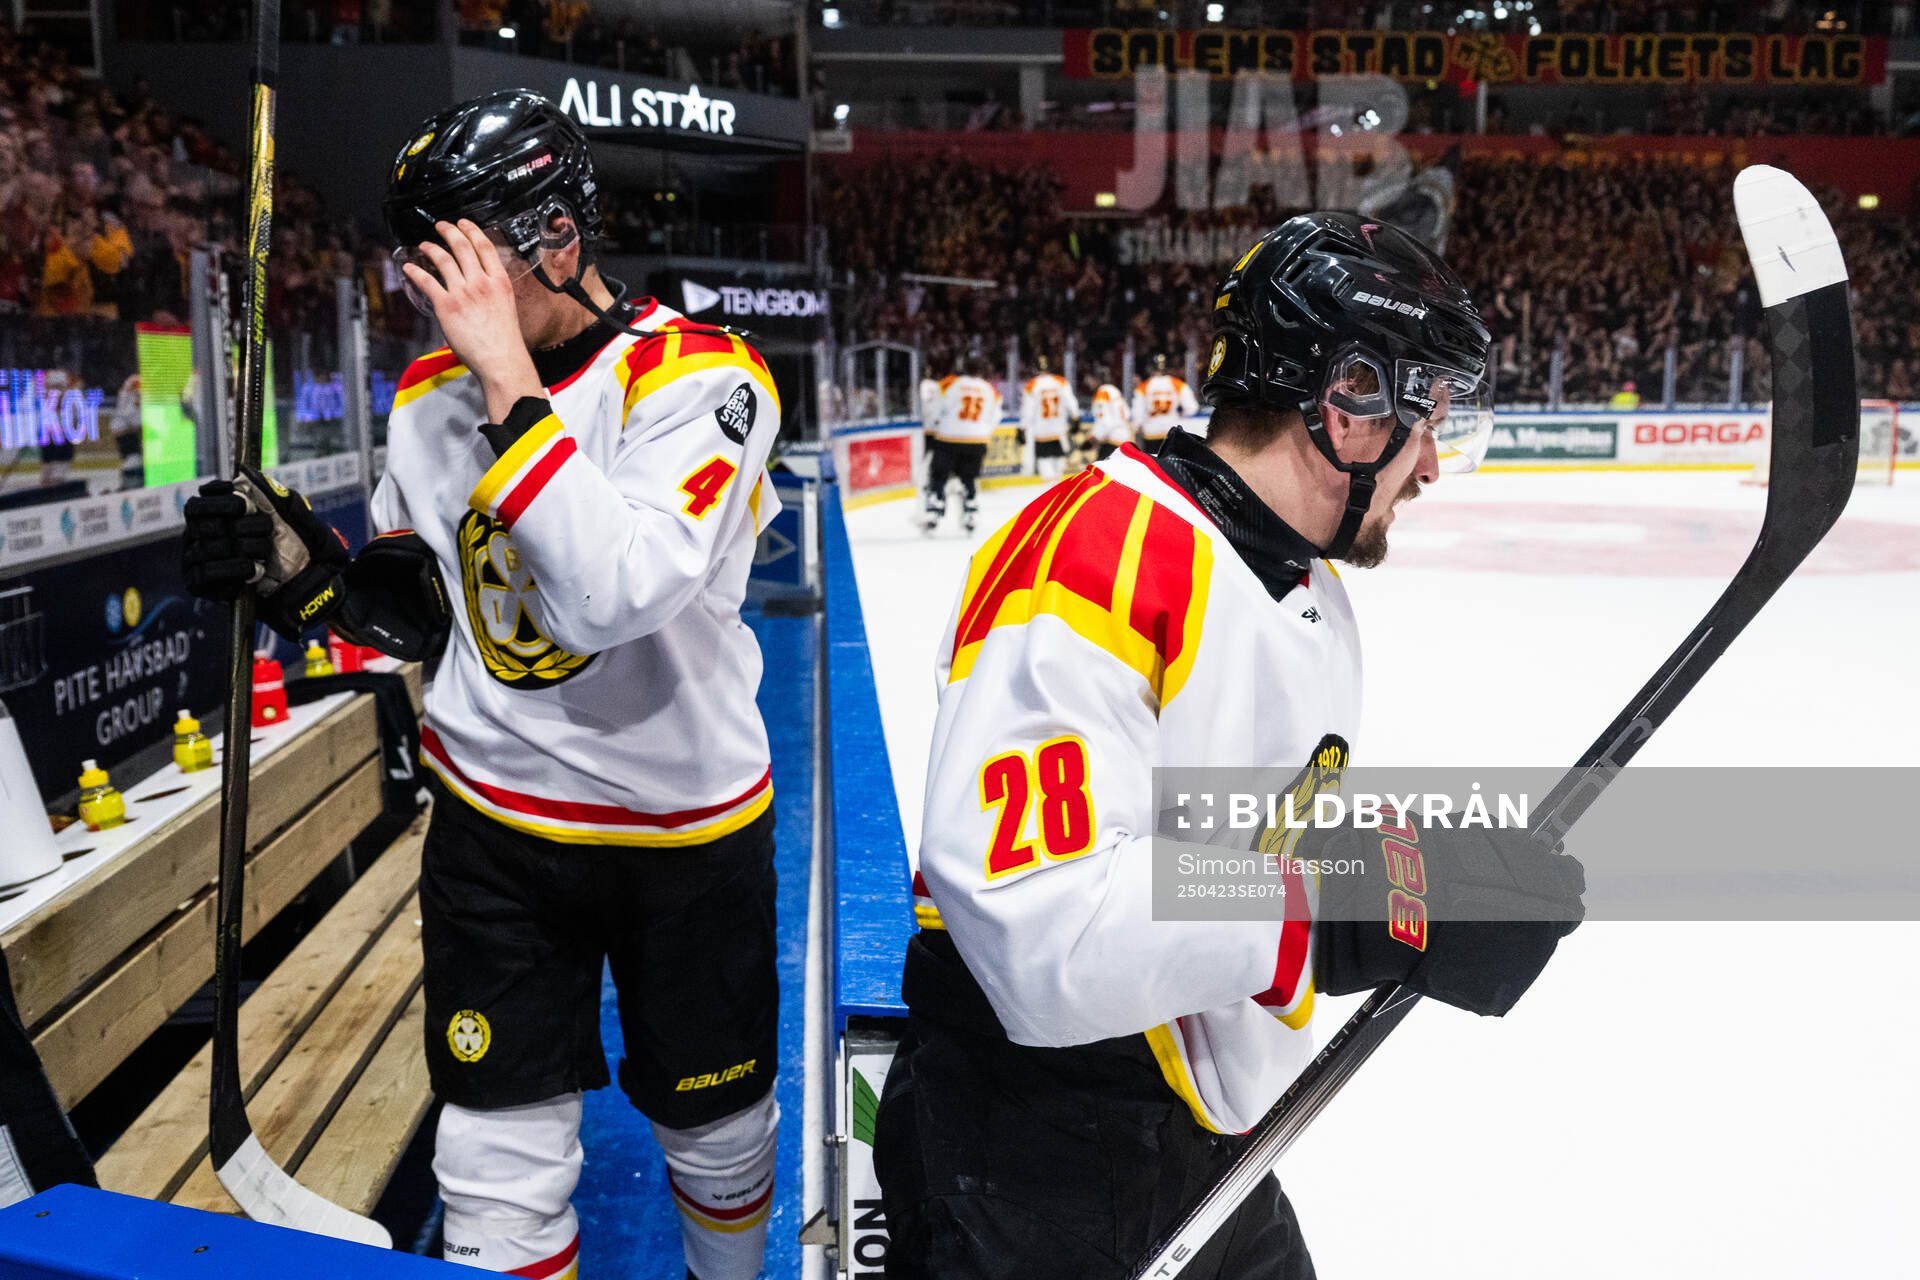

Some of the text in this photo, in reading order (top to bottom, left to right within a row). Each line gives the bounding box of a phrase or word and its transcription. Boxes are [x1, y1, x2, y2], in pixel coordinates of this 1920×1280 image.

[1091, 29, 1297, 80] SOLENS
[1308, 30, 1449, 81] STAD
[1526, 33, 1757, 84] FOLKETS
[1767, 34, 1864, 85] LAG
[1116, 65, 1412, 211] JIAB
[1352, 291, 1426, 320] BAUER
[726, 399, 749, 421] BRA
[734, 388, 749, 403] EN
[720, 408, 748, 438] STAR
[1634, 422, 1764, 445] BORGA
[677, 455, 738, 520] 4
[299, 586, 335, 620] MACH
[53, 630, 192, 716] PITE HAVSBAD
[96, 687, 164, 747] GROUP
[978, 735, 1097, 881] 28
[675, 1059, 757, 1091] BAUER
[443, 1241, 480, 1257] AUER
